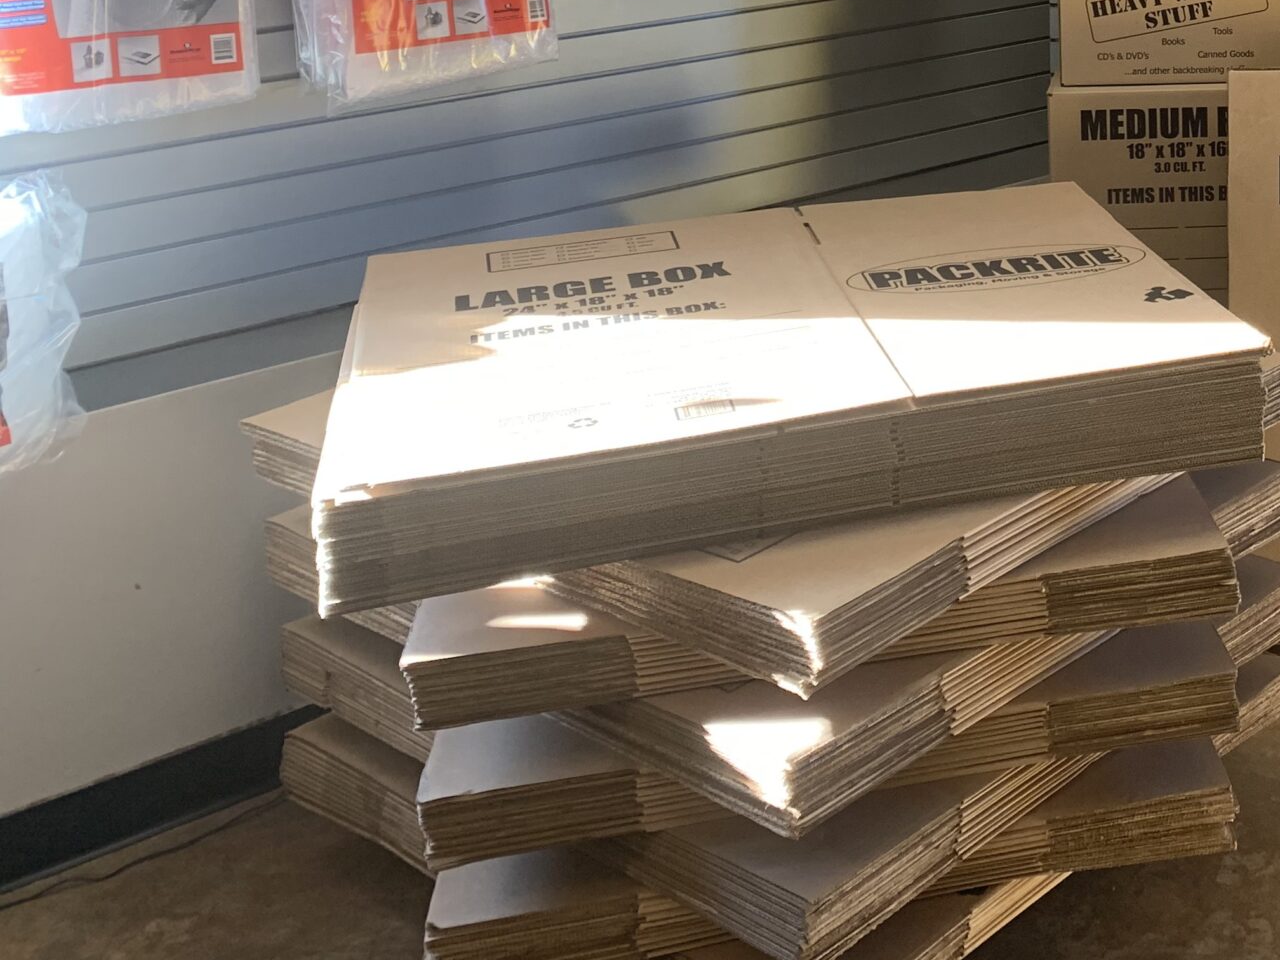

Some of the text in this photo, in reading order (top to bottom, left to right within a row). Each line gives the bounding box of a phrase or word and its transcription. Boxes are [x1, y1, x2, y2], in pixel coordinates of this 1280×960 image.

[1145, 1, 1213, 30] STUFF
[1080, 107, 1208, 141] MEDIUM
[454, 261, 732, 312] LARGE BOX
[865, 246, 1127, 290] PACKRITE
[470, 300, 727, 345] ITEMS IN THIS BOX:
